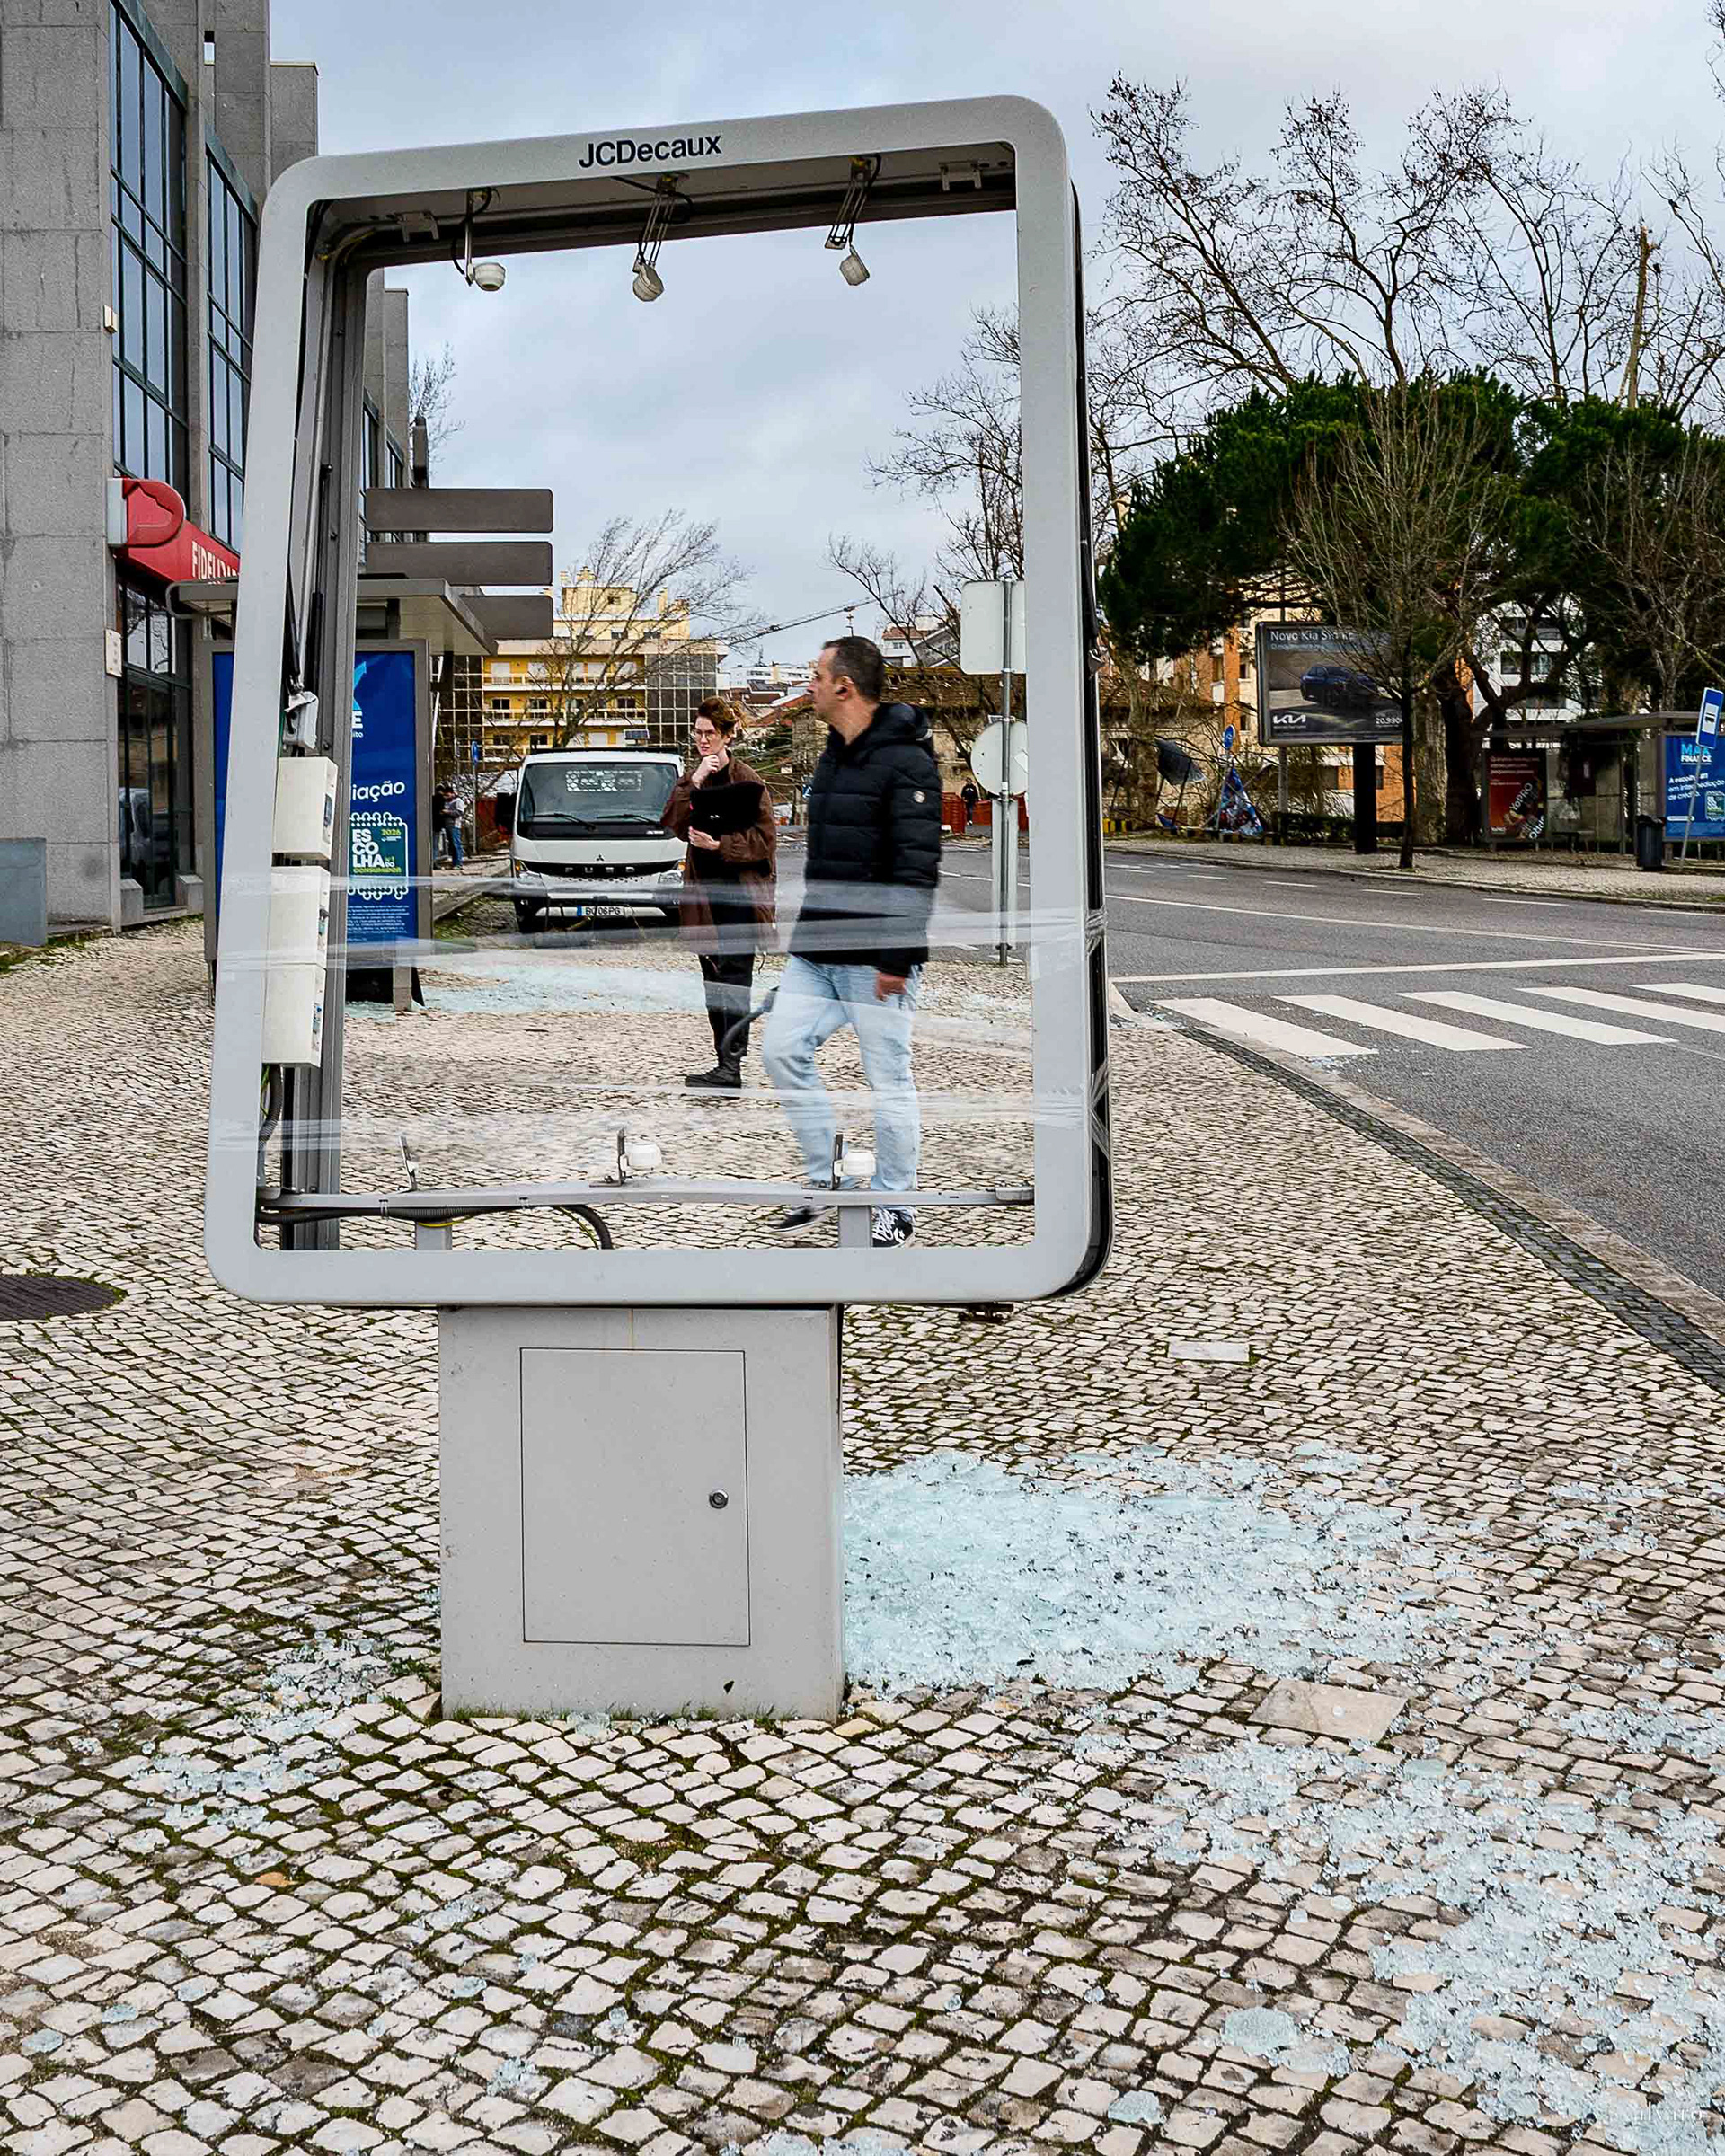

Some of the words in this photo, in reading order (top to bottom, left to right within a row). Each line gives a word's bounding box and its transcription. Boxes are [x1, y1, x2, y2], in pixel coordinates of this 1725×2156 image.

[579, 135, 722, 169] JCDecaux
[1273, 714, 1307, 724] KIA
[1509, 782, 1533, 810] YoPRO
[352, 828, 372, 843] ES
[352, 842, 379, 855] CO
[352, 853, 385, 868] LHA
